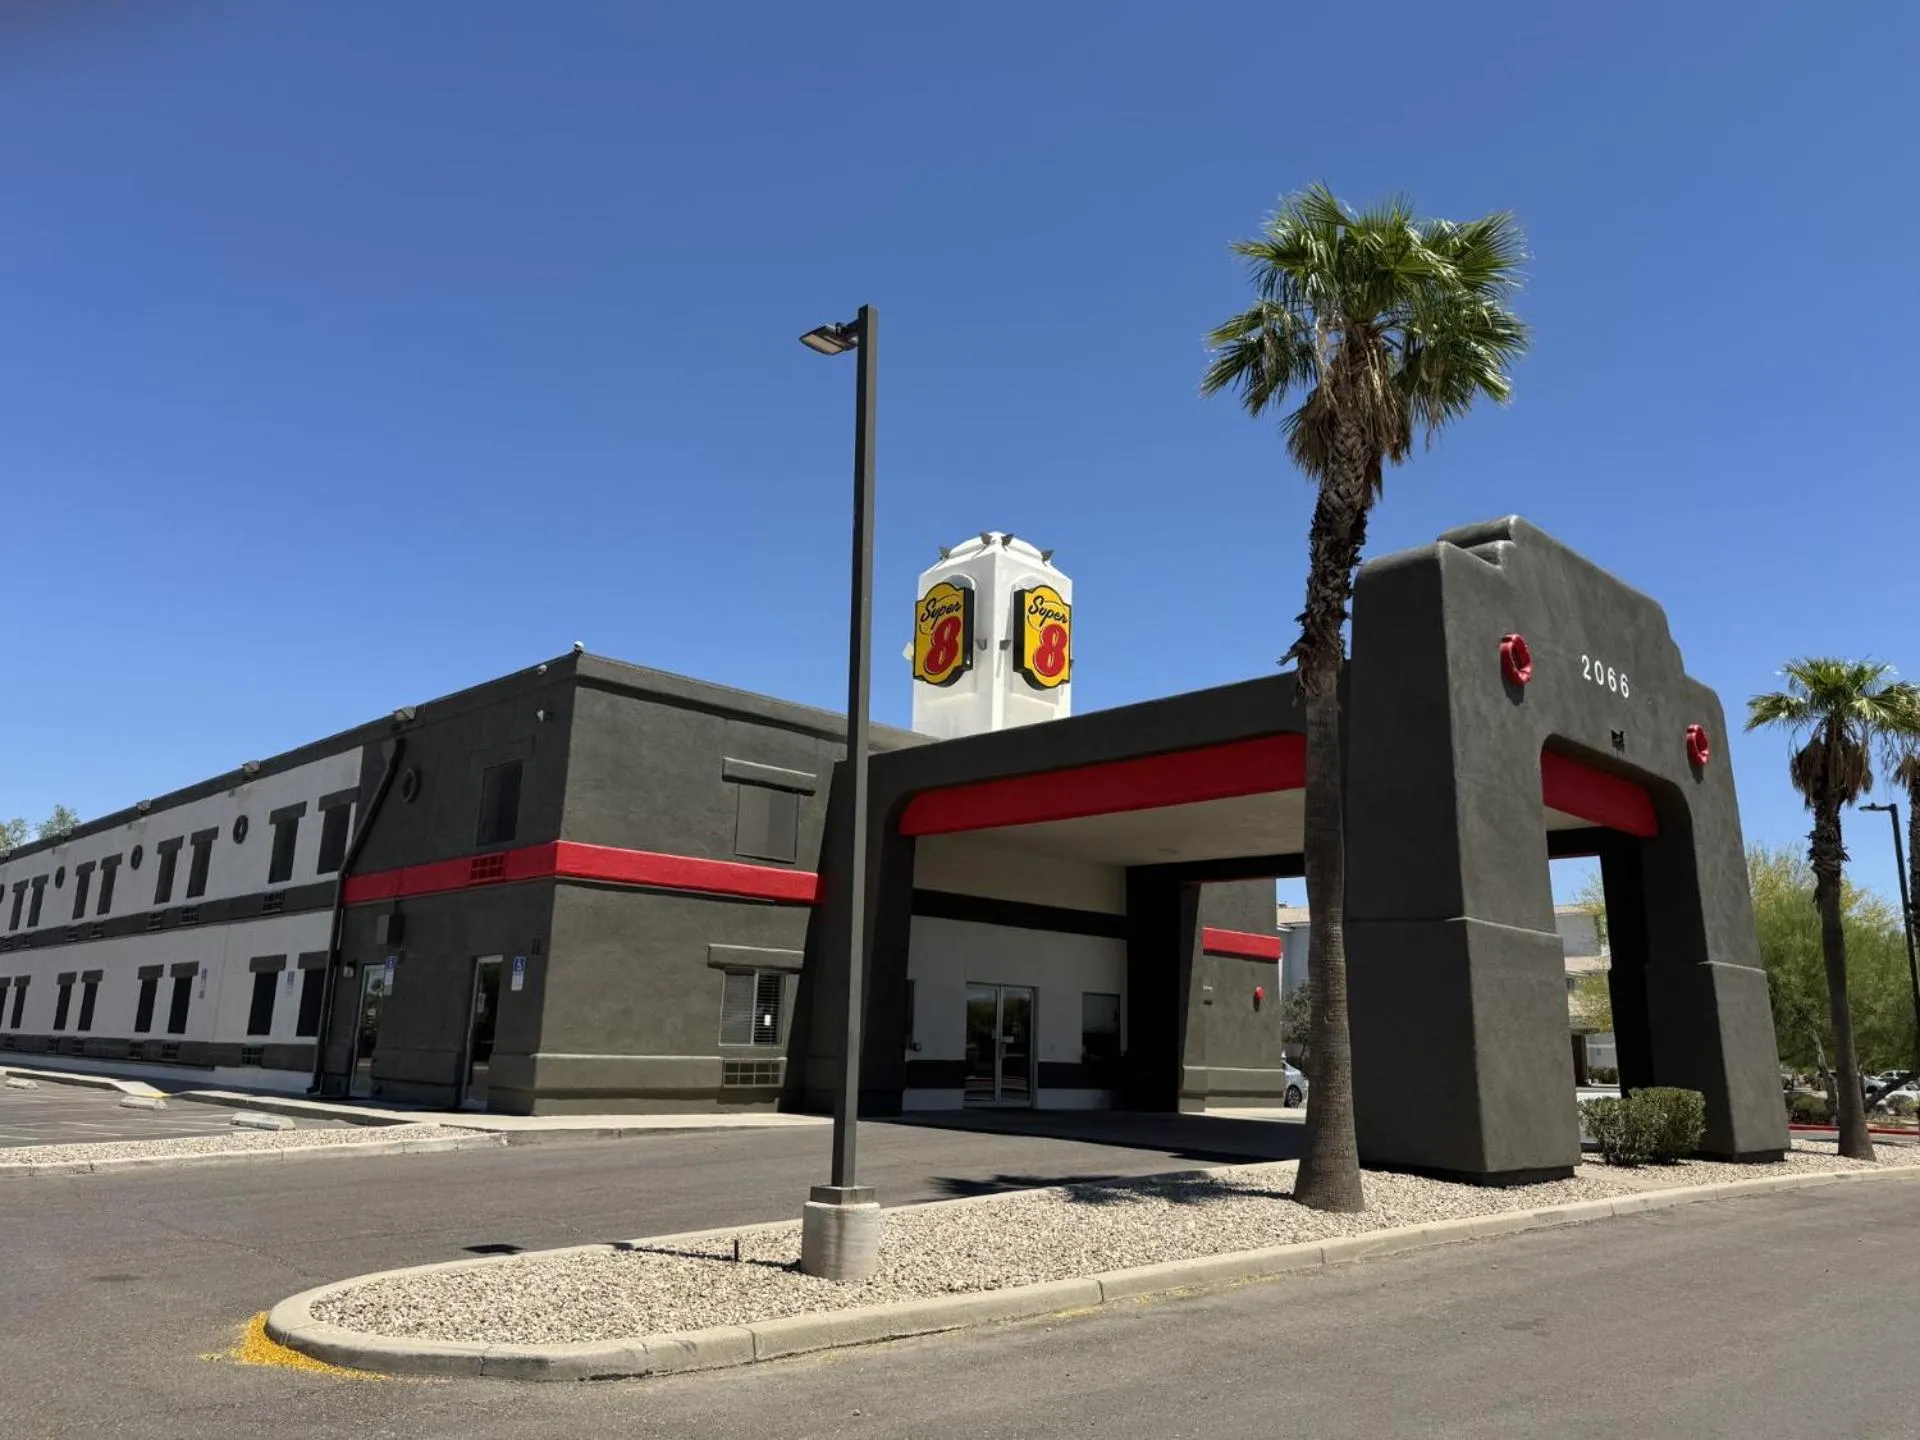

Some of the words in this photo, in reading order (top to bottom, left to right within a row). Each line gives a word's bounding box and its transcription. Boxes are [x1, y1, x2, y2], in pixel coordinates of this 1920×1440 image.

[920, 597, 961, 629] Super
[1028, 595, 1067, 627] Super
[924, 616, 961, 675] 8
[1033, 624, 1067, 677] 8
[1581, 654, 1629, 698] 2066
